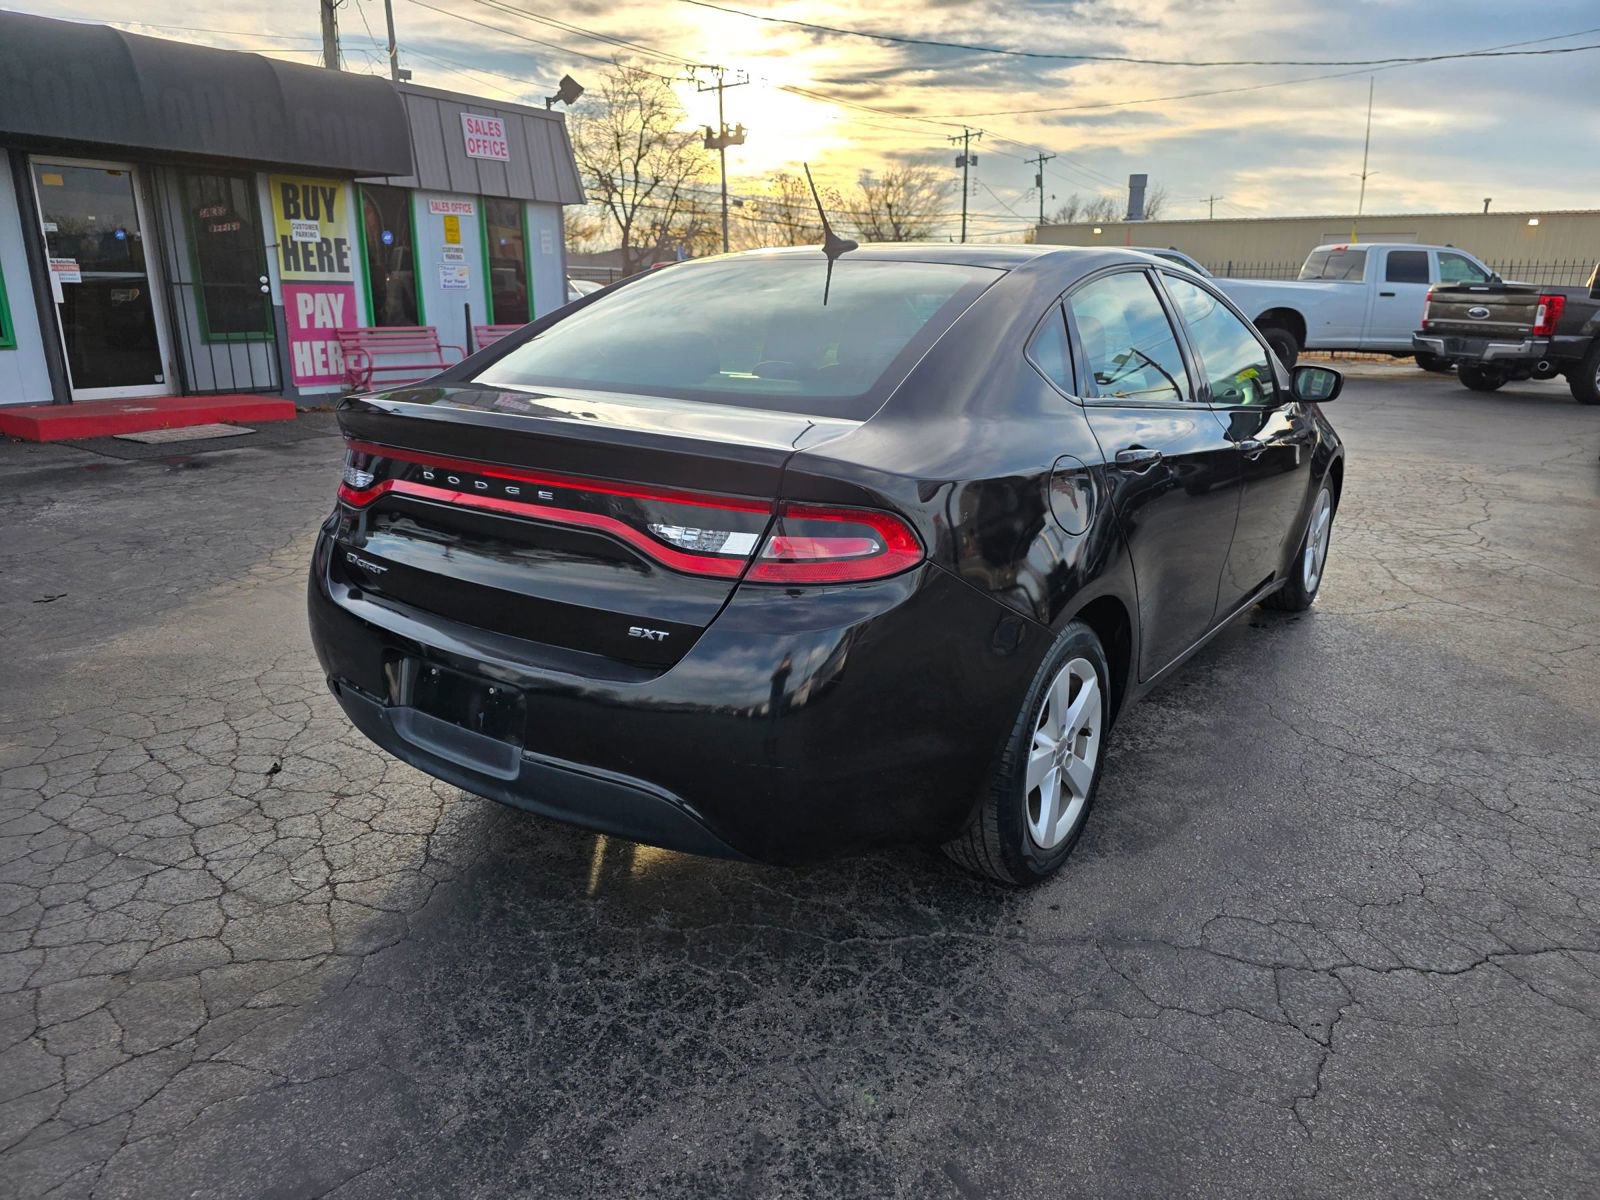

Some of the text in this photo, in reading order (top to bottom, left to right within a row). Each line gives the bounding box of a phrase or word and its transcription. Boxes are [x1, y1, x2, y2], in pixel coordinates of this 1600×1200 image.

[466, 118, 502, 138] SALES
[467, 137, 508, 157] OFFICE
[280, 183, 337, 223] BUY
[431, 201, 473, 214] SALES OFFICE
[291, 222, 319, 231] CUSTOMER
[295, 230, 318, 239] PARKING
[280, 234, 351, 273] HERE
[296, 292, 345, 329] PAY
[422, 470, 554, 500] DODGE
[627, 626, 670, 641] SXT
